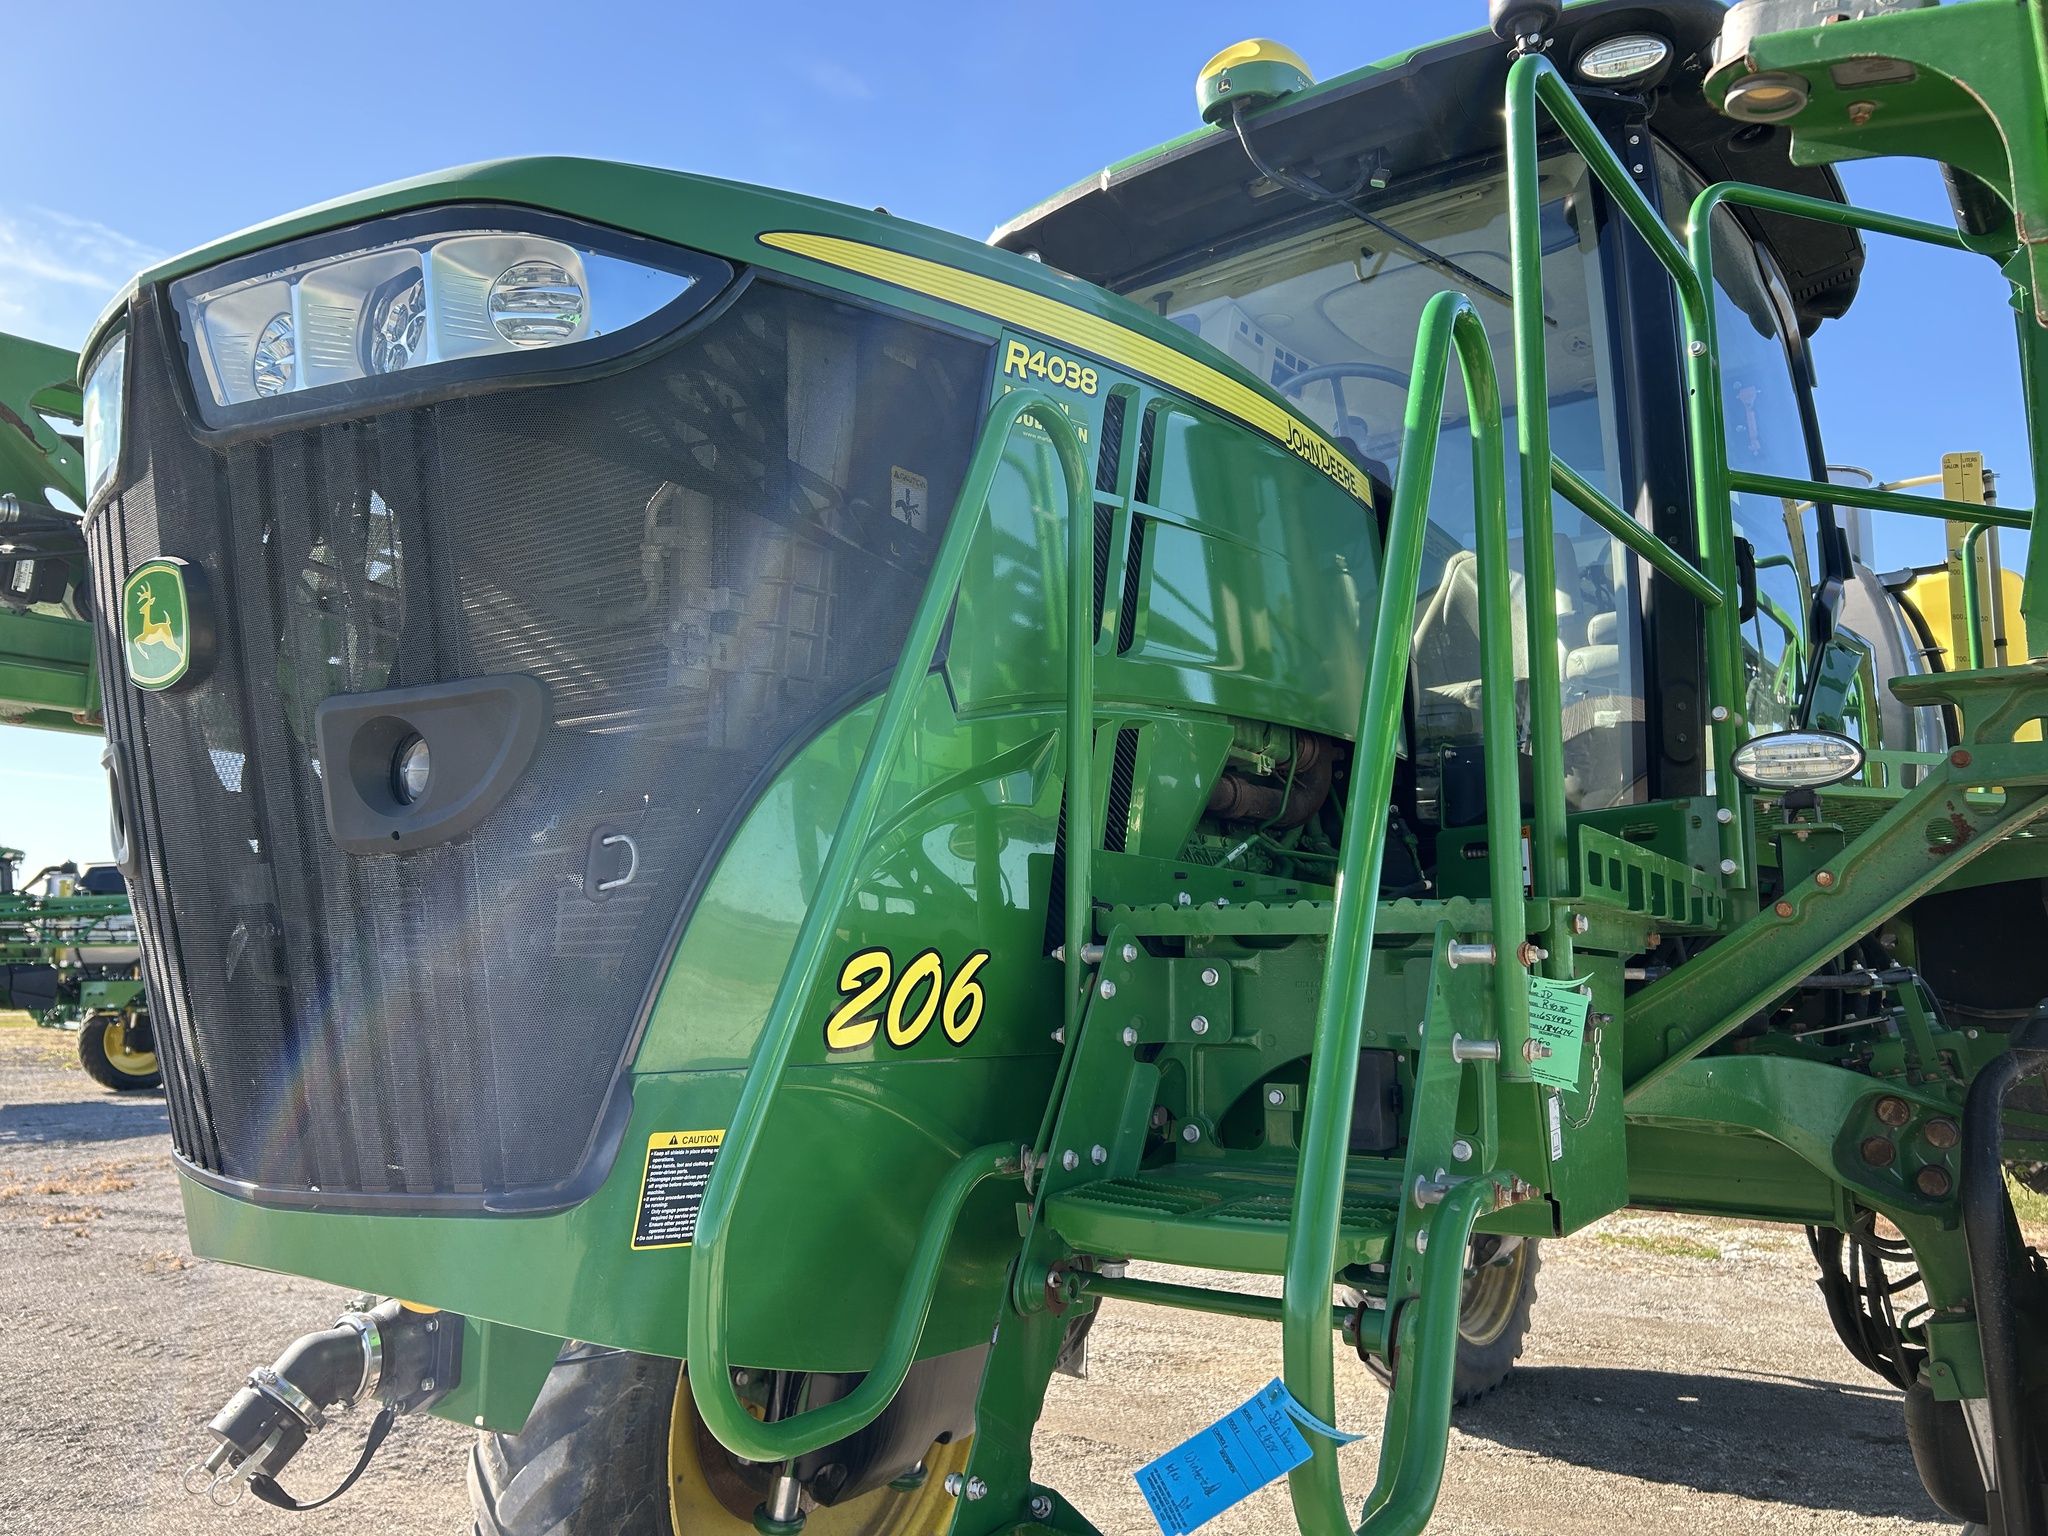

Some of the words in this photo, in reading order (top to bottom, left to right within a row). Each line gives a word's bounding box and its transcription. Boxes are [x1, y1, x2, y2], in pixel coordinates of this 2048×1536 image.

[1004, 339, 1099, 396] R4038
[1286, 419, 1320, 466] JOHN
[1320, 443, 1358, 495] DEERE
[823, 946, 991, 1053] 206
[1540, 989, 1553, 999] JD
[682, 1135, 719, 1144] CAUTION
